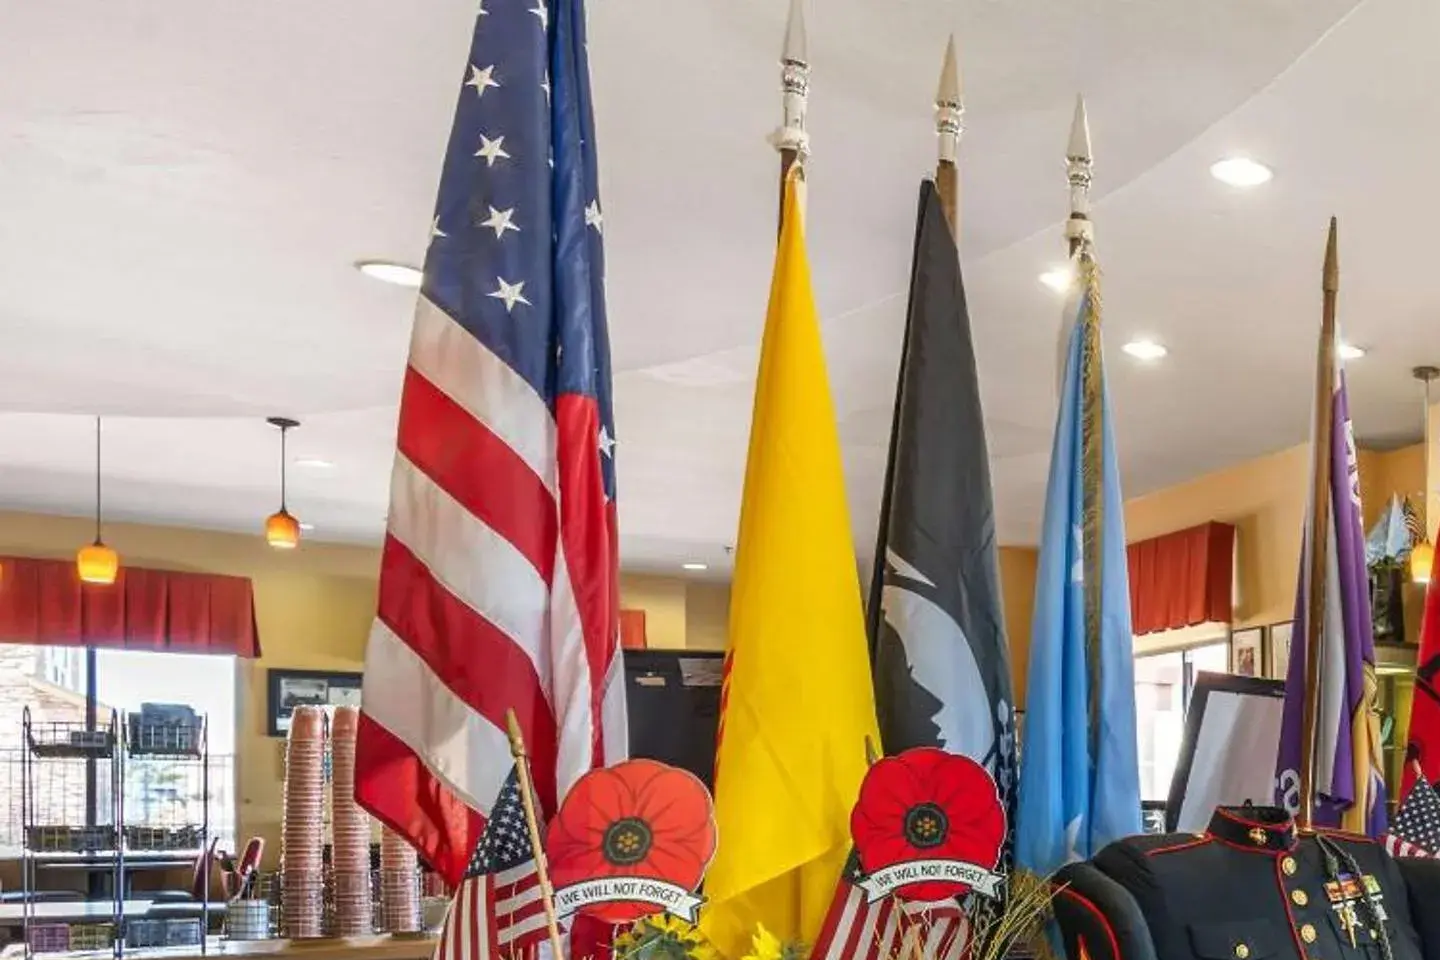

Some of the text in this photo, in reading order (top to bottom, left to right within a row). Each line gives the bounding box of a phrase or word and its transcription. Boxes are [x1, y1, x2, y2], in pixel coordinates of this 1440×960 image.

[875, 864, 984, 888] WE WILL NOT FORGET
[560, 882, 684, 905] WE WILL NOT FORGET
